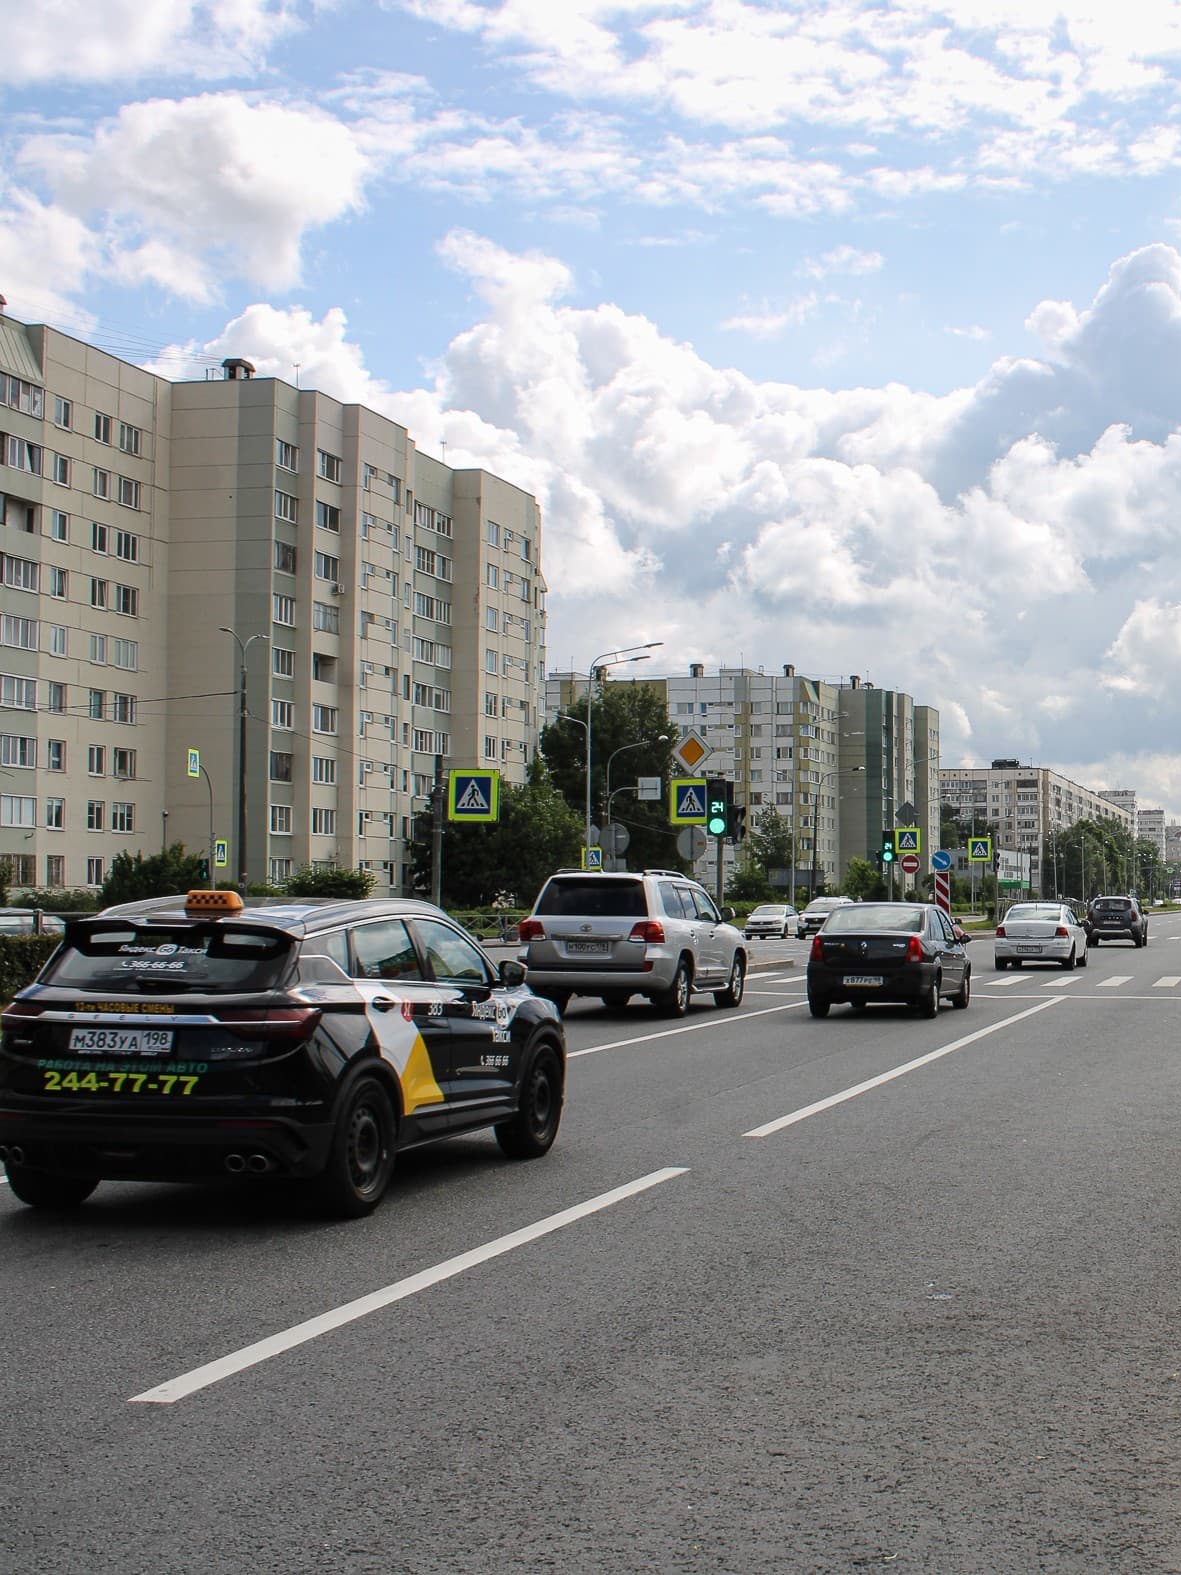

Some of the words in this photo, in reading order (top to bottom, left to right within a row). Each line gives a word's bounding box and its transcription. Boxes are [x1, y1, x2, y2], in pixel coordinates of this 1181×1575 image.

[711, 801, 724, 813] 24
[128, 960, 185, 969] 366-66-66
[428, 1000, 443, 1016] 383
[73, 1030, 138, 1050] М383УА
[143, 1031, 169, 1046] 198
[44, 1071, 199, 1096] 244-77-77
